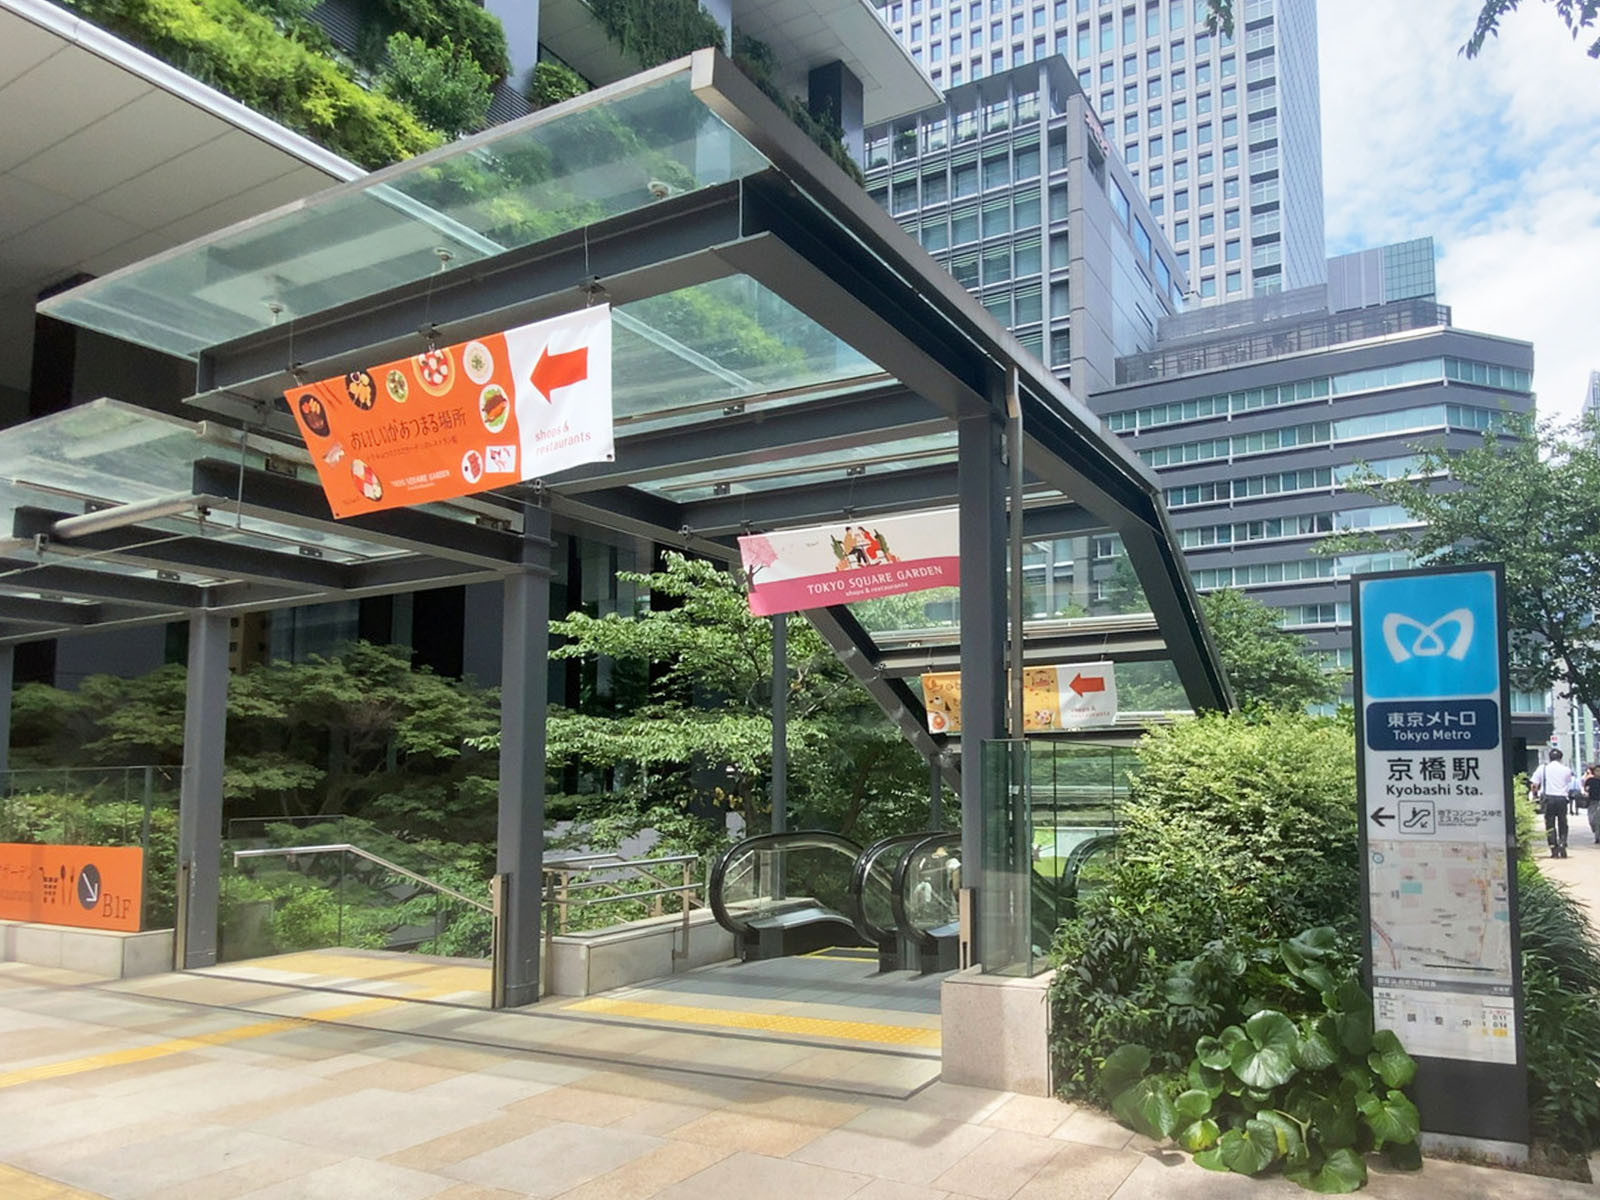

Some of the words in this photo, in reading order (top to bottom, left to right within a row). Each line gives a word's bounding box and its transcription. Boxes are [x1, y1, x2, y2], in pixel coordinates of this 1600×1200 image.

[351, 407, 467, 450] おいしいがあつまる場所
[535, 426, 561, 442] shops
[536, 432, 592, 456] restaurants
[807, 580, 845, 596] TOKYO
[849, 572, 893, 588] SQUARE
[897, 565, 944, 582] GARDEN
[846, 588, 864, 597] shops
[1387, 710, 1477, 728] 東京メトロ
[1393, 730, 1430, 743] Tokyo
[1433, 729, 1471, 741] Metro
[1387, 757, 1481, 782] 京橋駅
[1386, 783, 1451, 798] Kyobashi
[1456, 784, 1483, 796] Sta.
[102, 893, 132, 919] B1F
